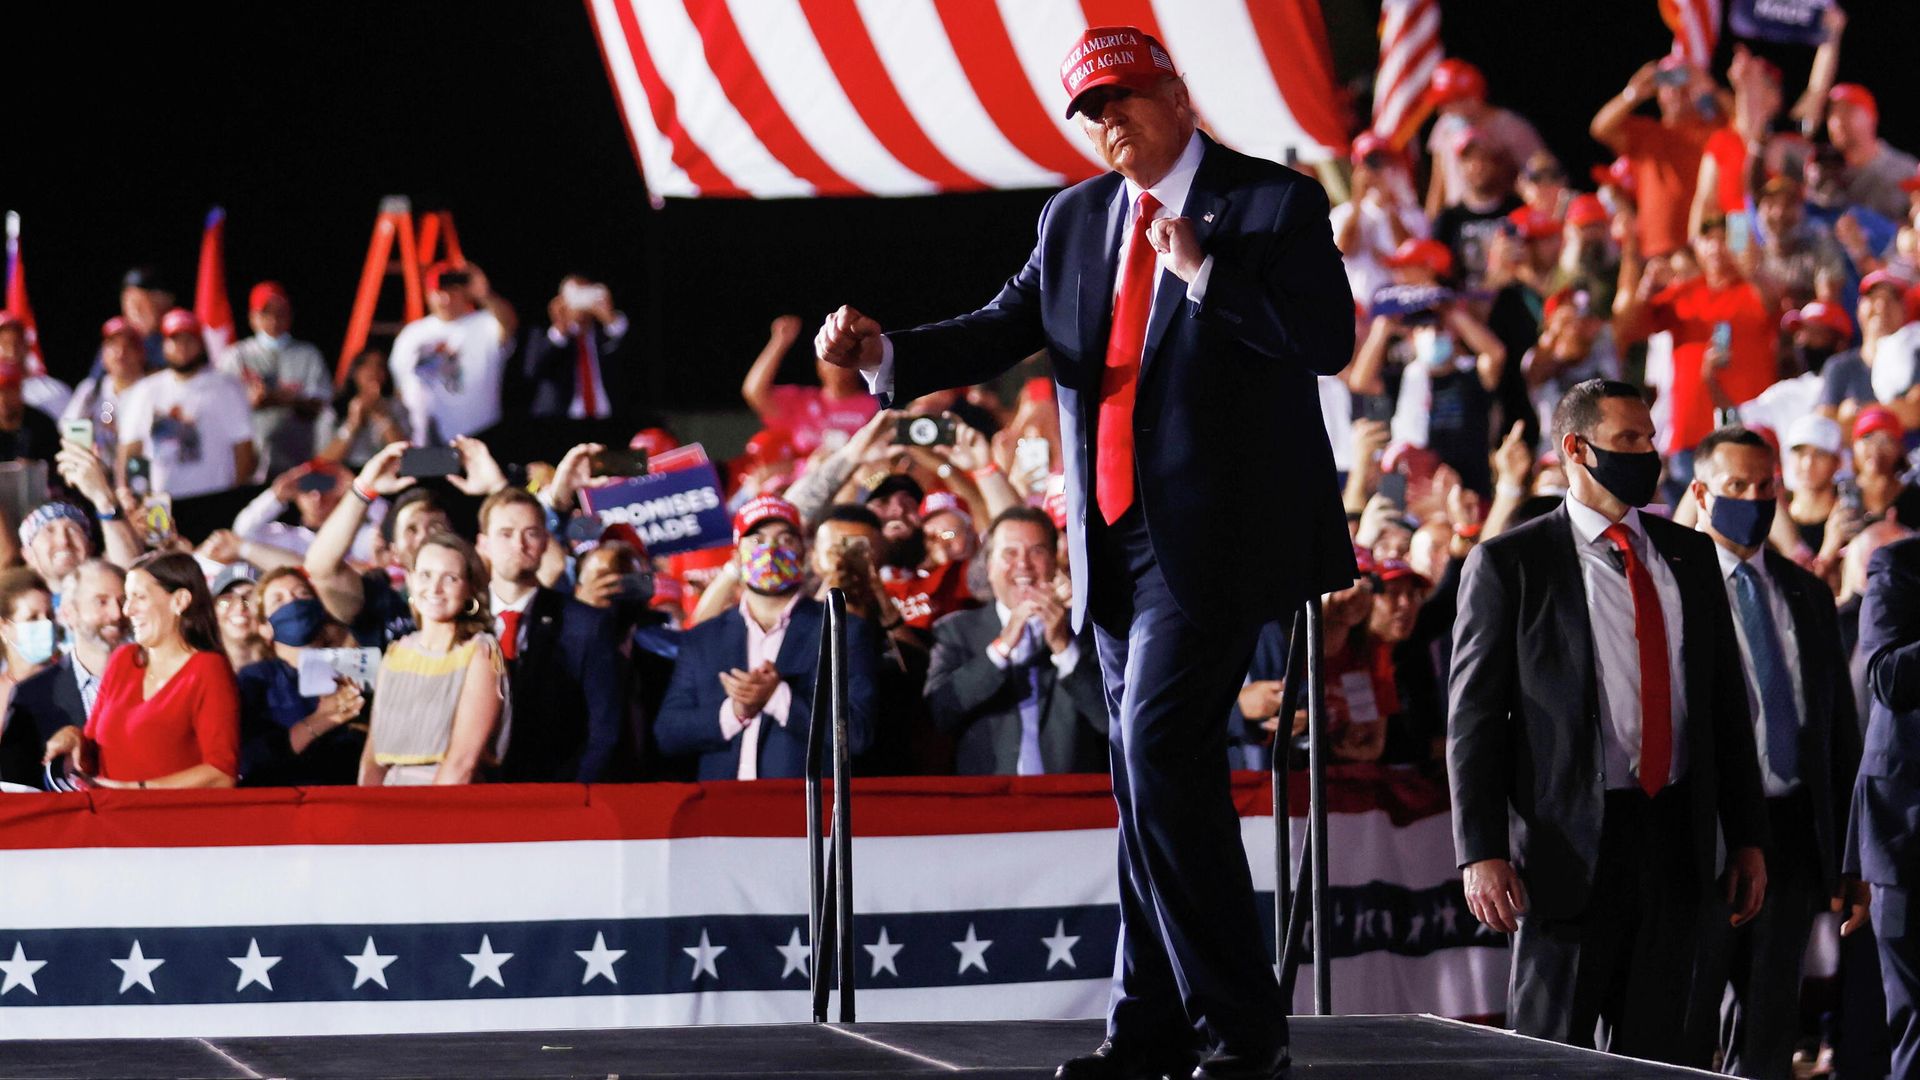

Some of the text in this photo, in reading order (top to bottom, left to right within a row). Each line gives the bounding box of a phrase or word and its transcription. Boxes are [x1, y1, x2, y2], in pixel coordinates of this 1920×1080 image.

[1061, 33, 1138, 78] MAKE AMERICA
[1068, 51, 1135, 90] GREAT AGAIN
[597, 486, 720, 527] PROMISES
